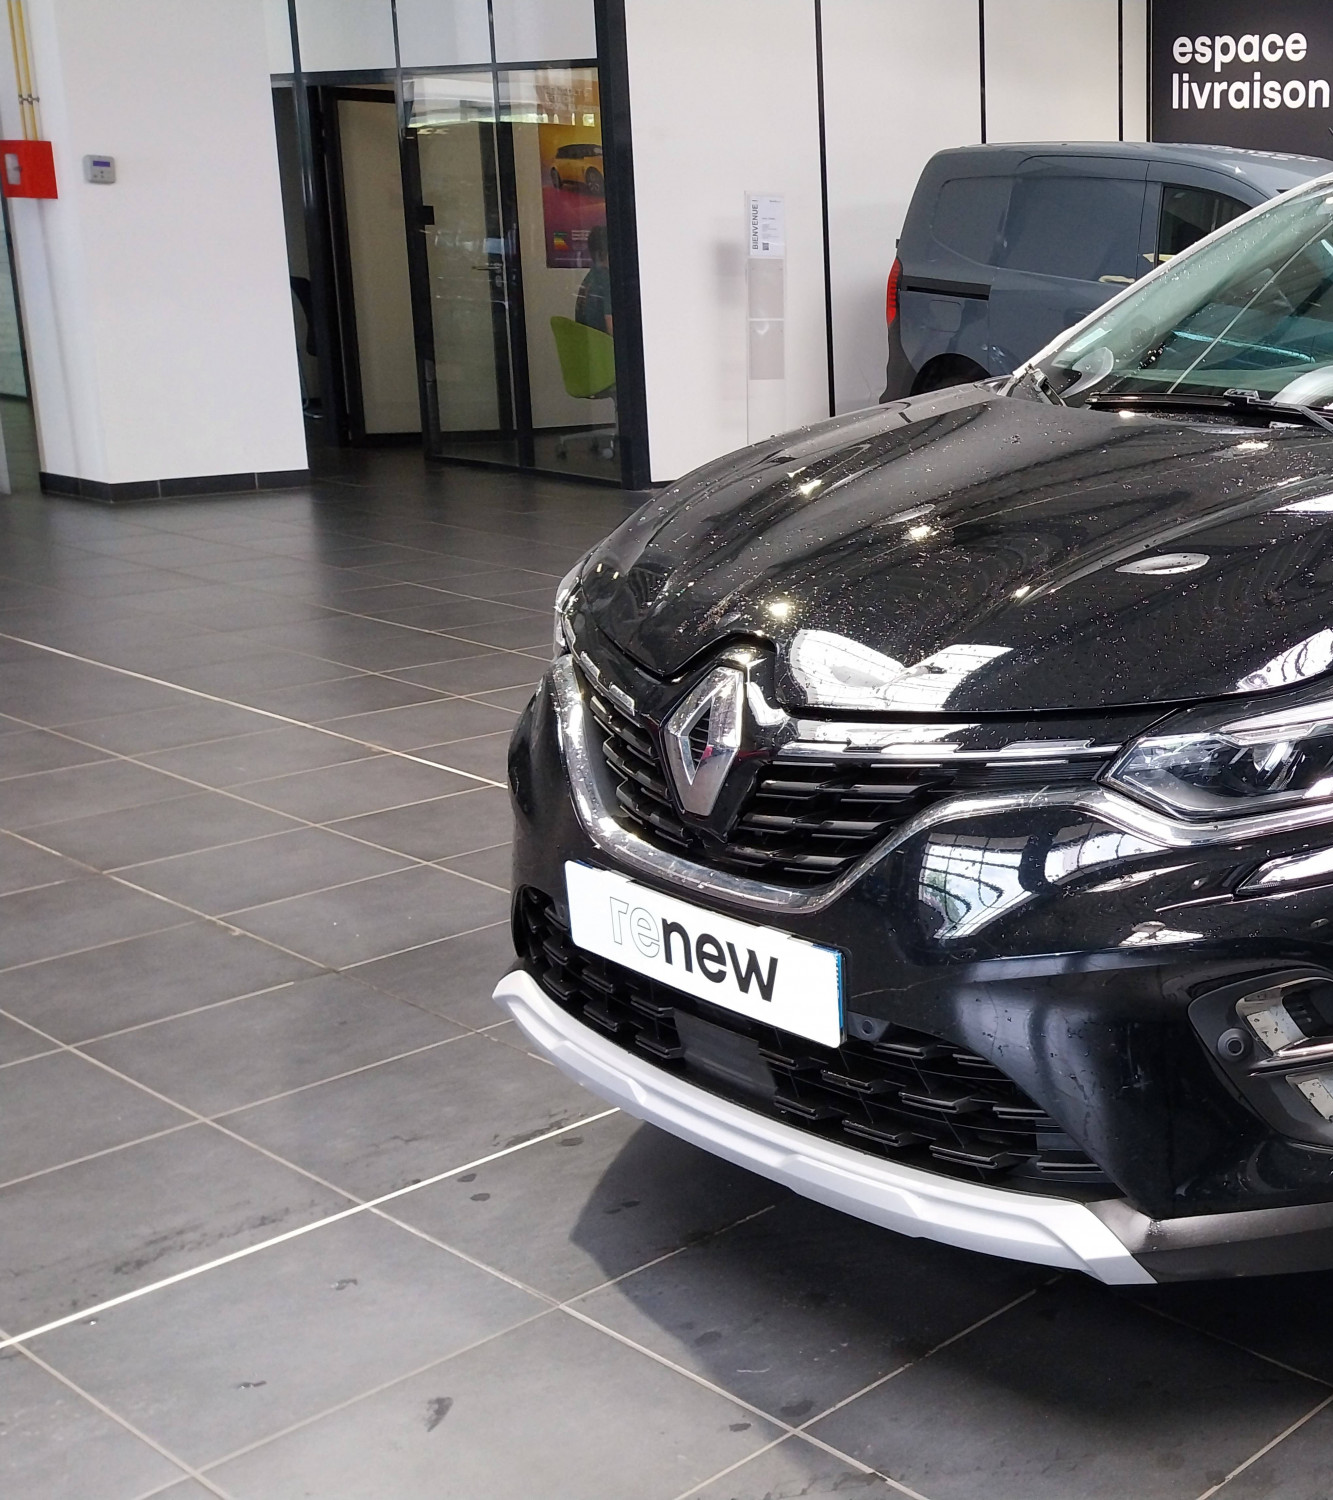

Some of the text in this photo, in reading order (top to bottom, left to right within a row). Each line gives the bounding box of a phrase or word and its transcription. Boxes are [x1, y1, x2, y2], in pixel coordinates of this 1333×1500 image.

[1172, 32, 1308, 73] espace
[1172, 71, 1331, 109] livraison
[751, 203, 759, 250] BIENVENUE
[609, 896, 779, 1003] renew
